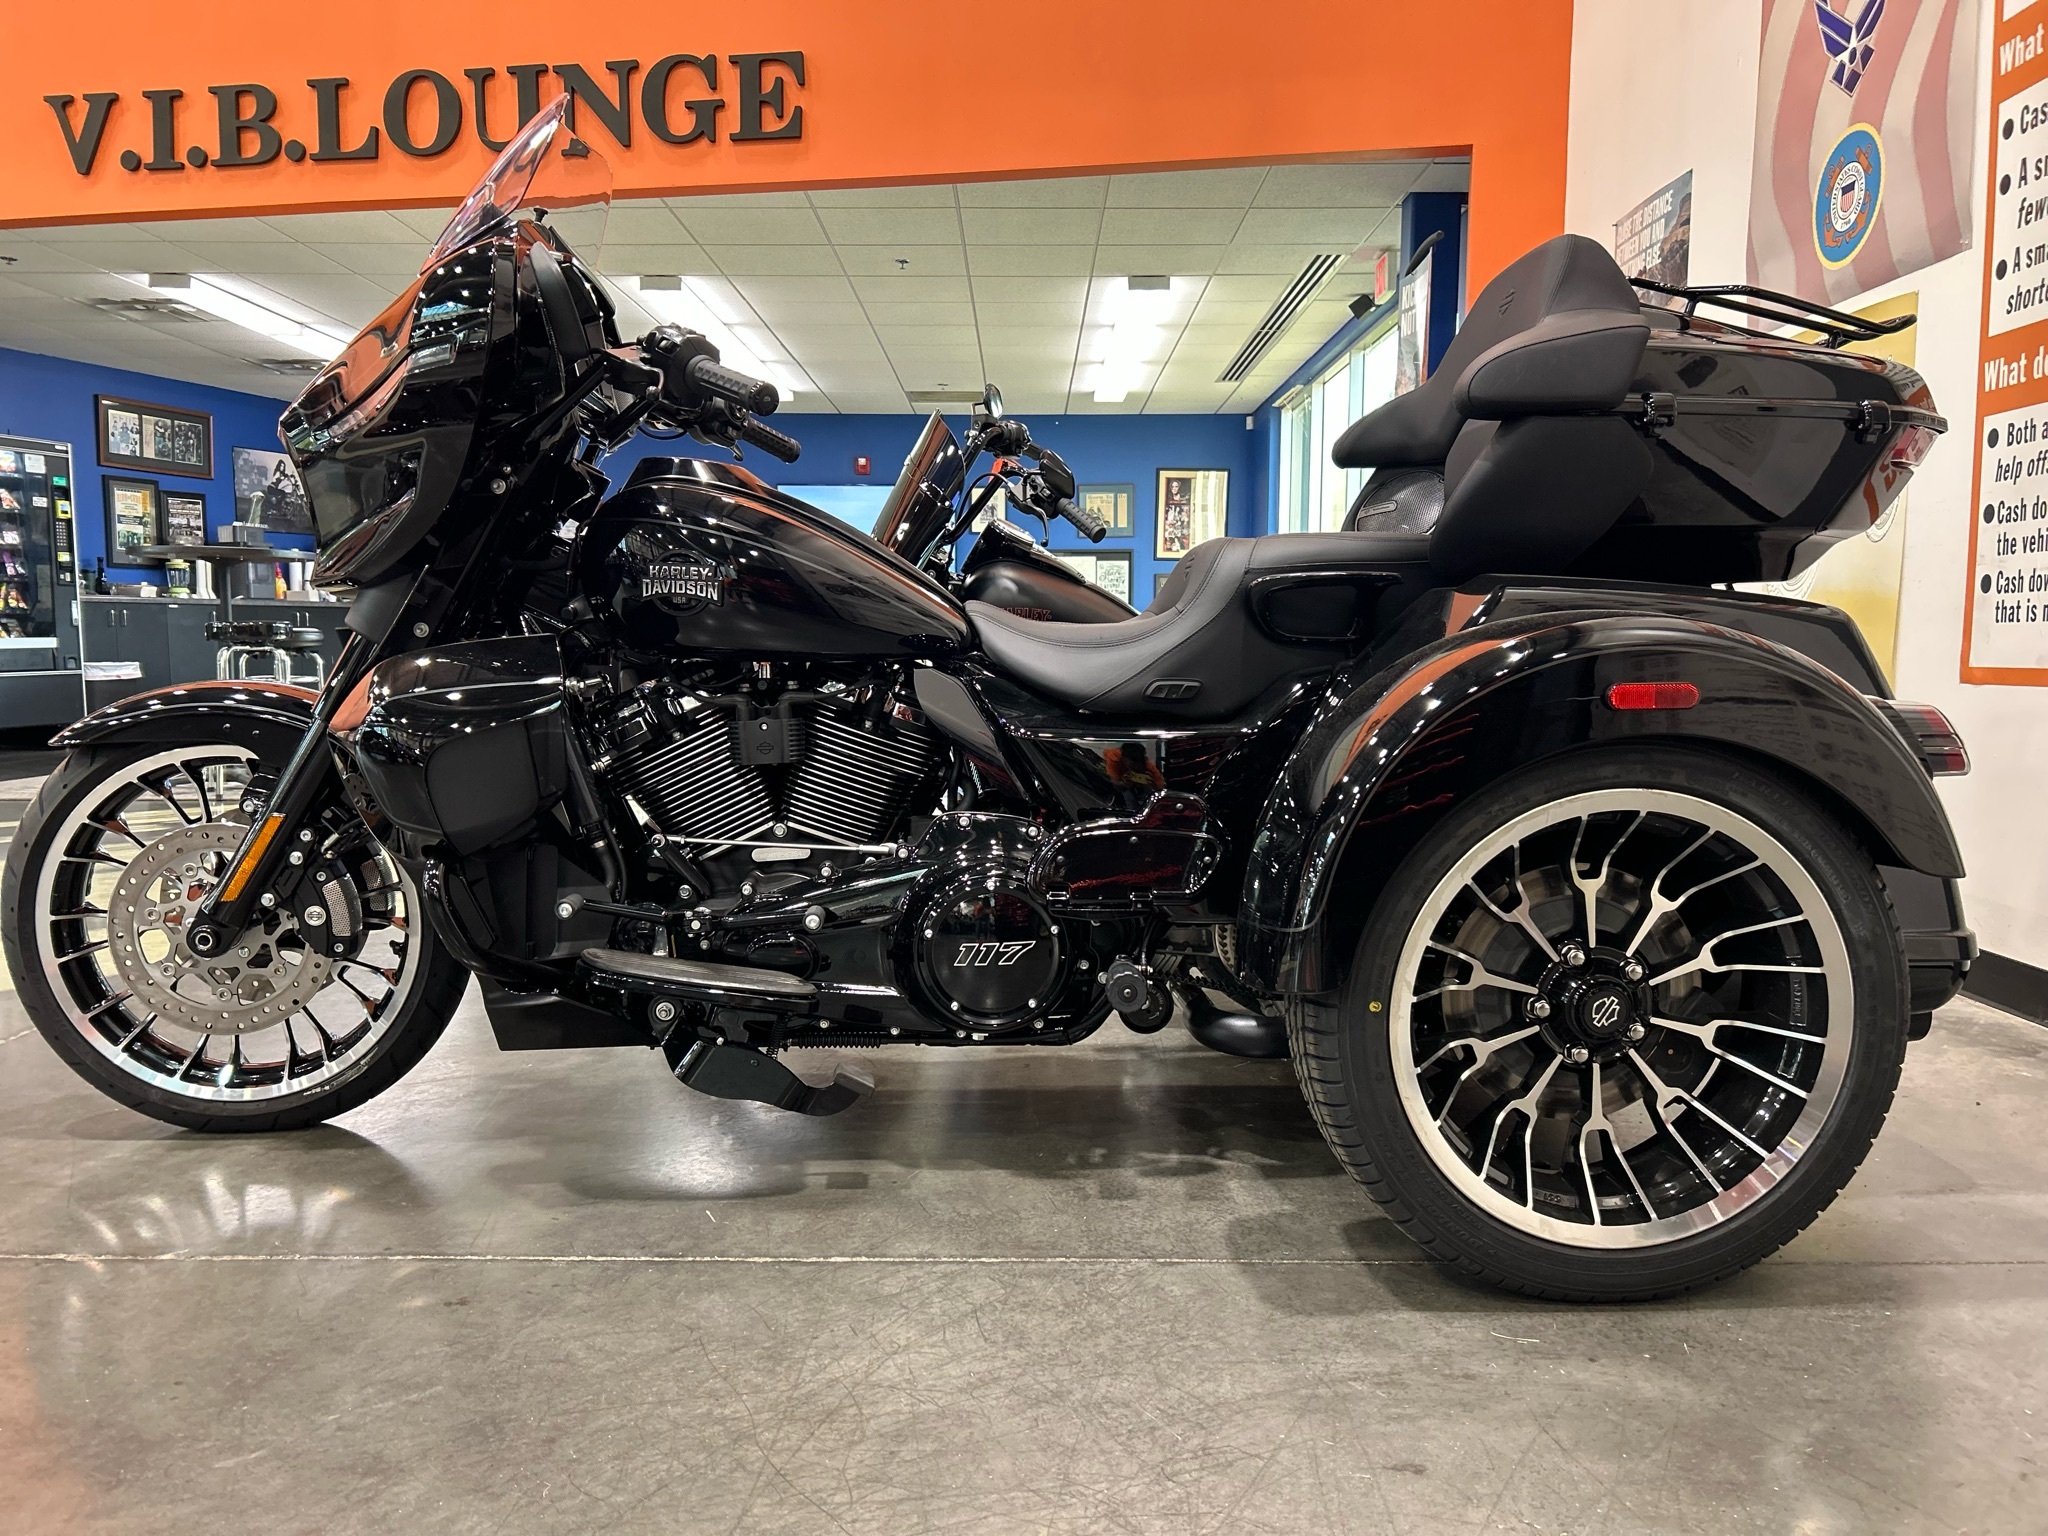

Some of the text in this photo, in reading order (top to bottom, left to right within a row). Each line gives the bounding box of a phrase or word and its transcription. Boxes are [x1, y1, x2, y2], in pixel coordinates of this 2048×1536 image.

[1999, 22, 2045, 76] What
[2018, 157, 2028, 189] A
[2012, 246, 2021, 274] A
[1984, 351, 2027, 393] What
[2006, 418, 2037, 448] Both
[1995, 455, 2023, 486] help
[1997, 497, 2027, 525] Cash
[1997, 531, 2017, 556] the
[649, 565, 713, 580] HARLEY-
[1996, 568, 2024, 594] Cash
[642, 578, 719, 601] DAVIDSON
[1995, 599, 2022, 623] that
[2026, 598, 2037, 623] is
[953, 940, 1036, 967] 117
